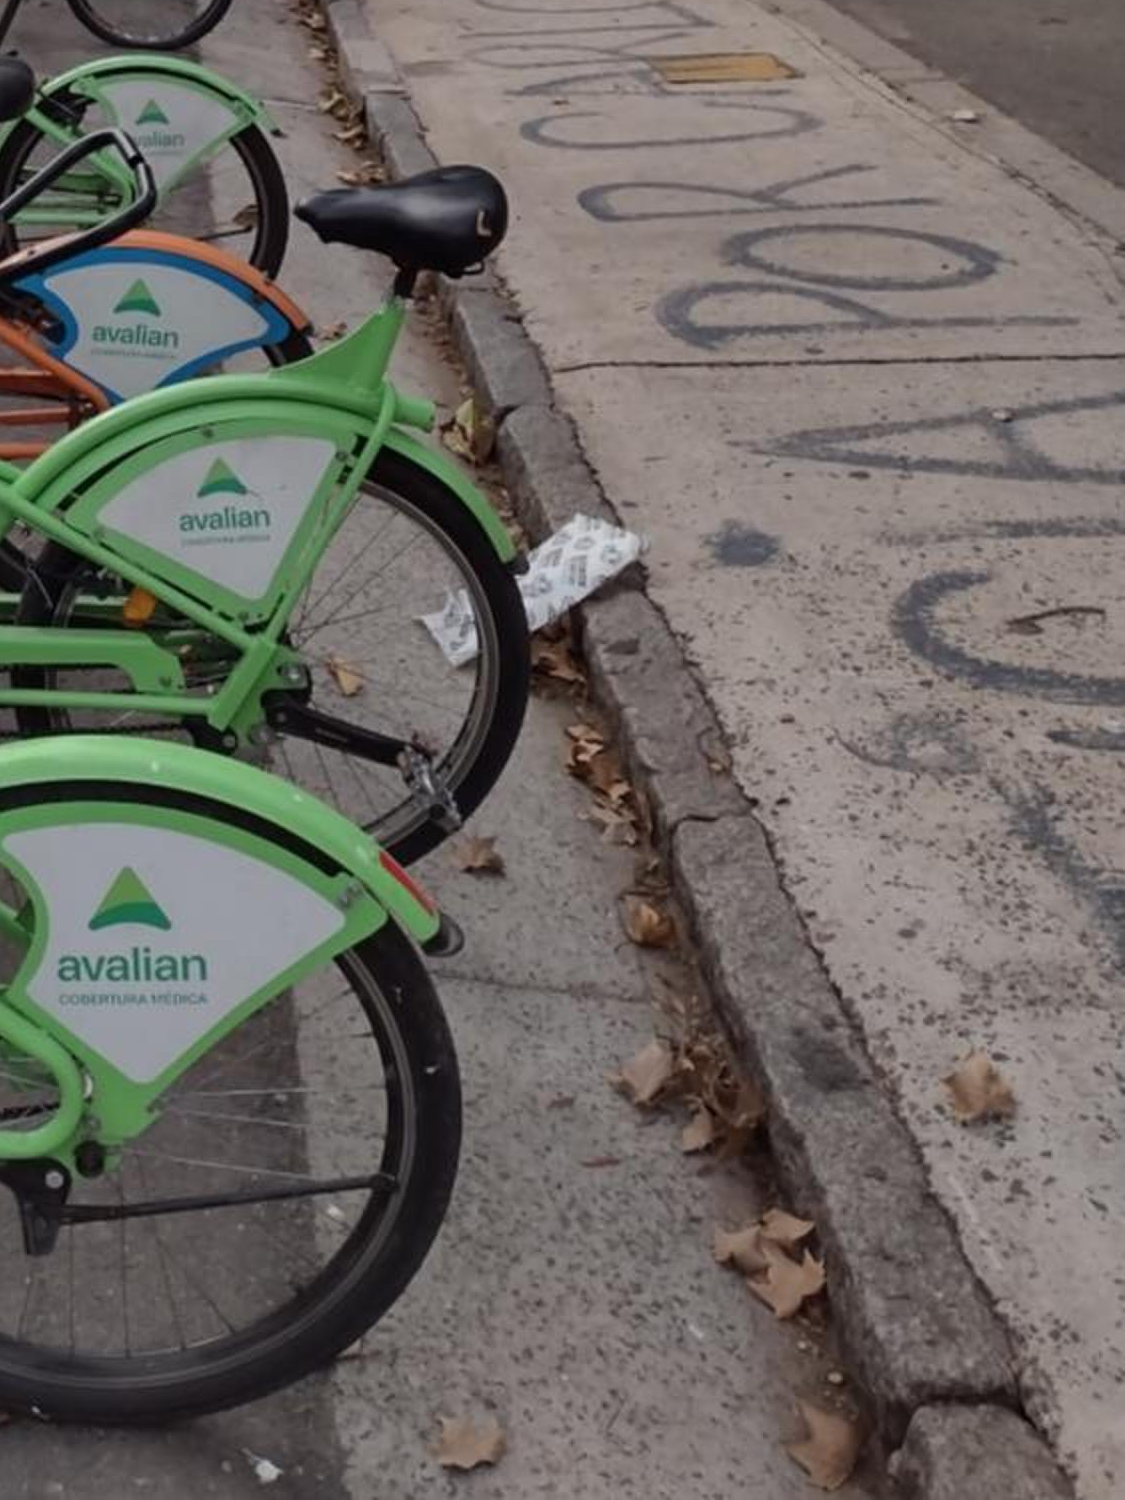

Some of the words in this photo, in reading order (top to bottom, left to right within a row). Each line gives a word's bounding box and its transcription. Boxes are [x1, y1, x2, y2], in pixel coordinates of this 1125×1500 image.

[577, 163, 1081, 352] POR
[91, 323, 180, 349] avalian
[179, 506, 270, 531] avalian
[57, 946, 208, 982] avalian
[58, 992, 147, 1006] COBERTURA
